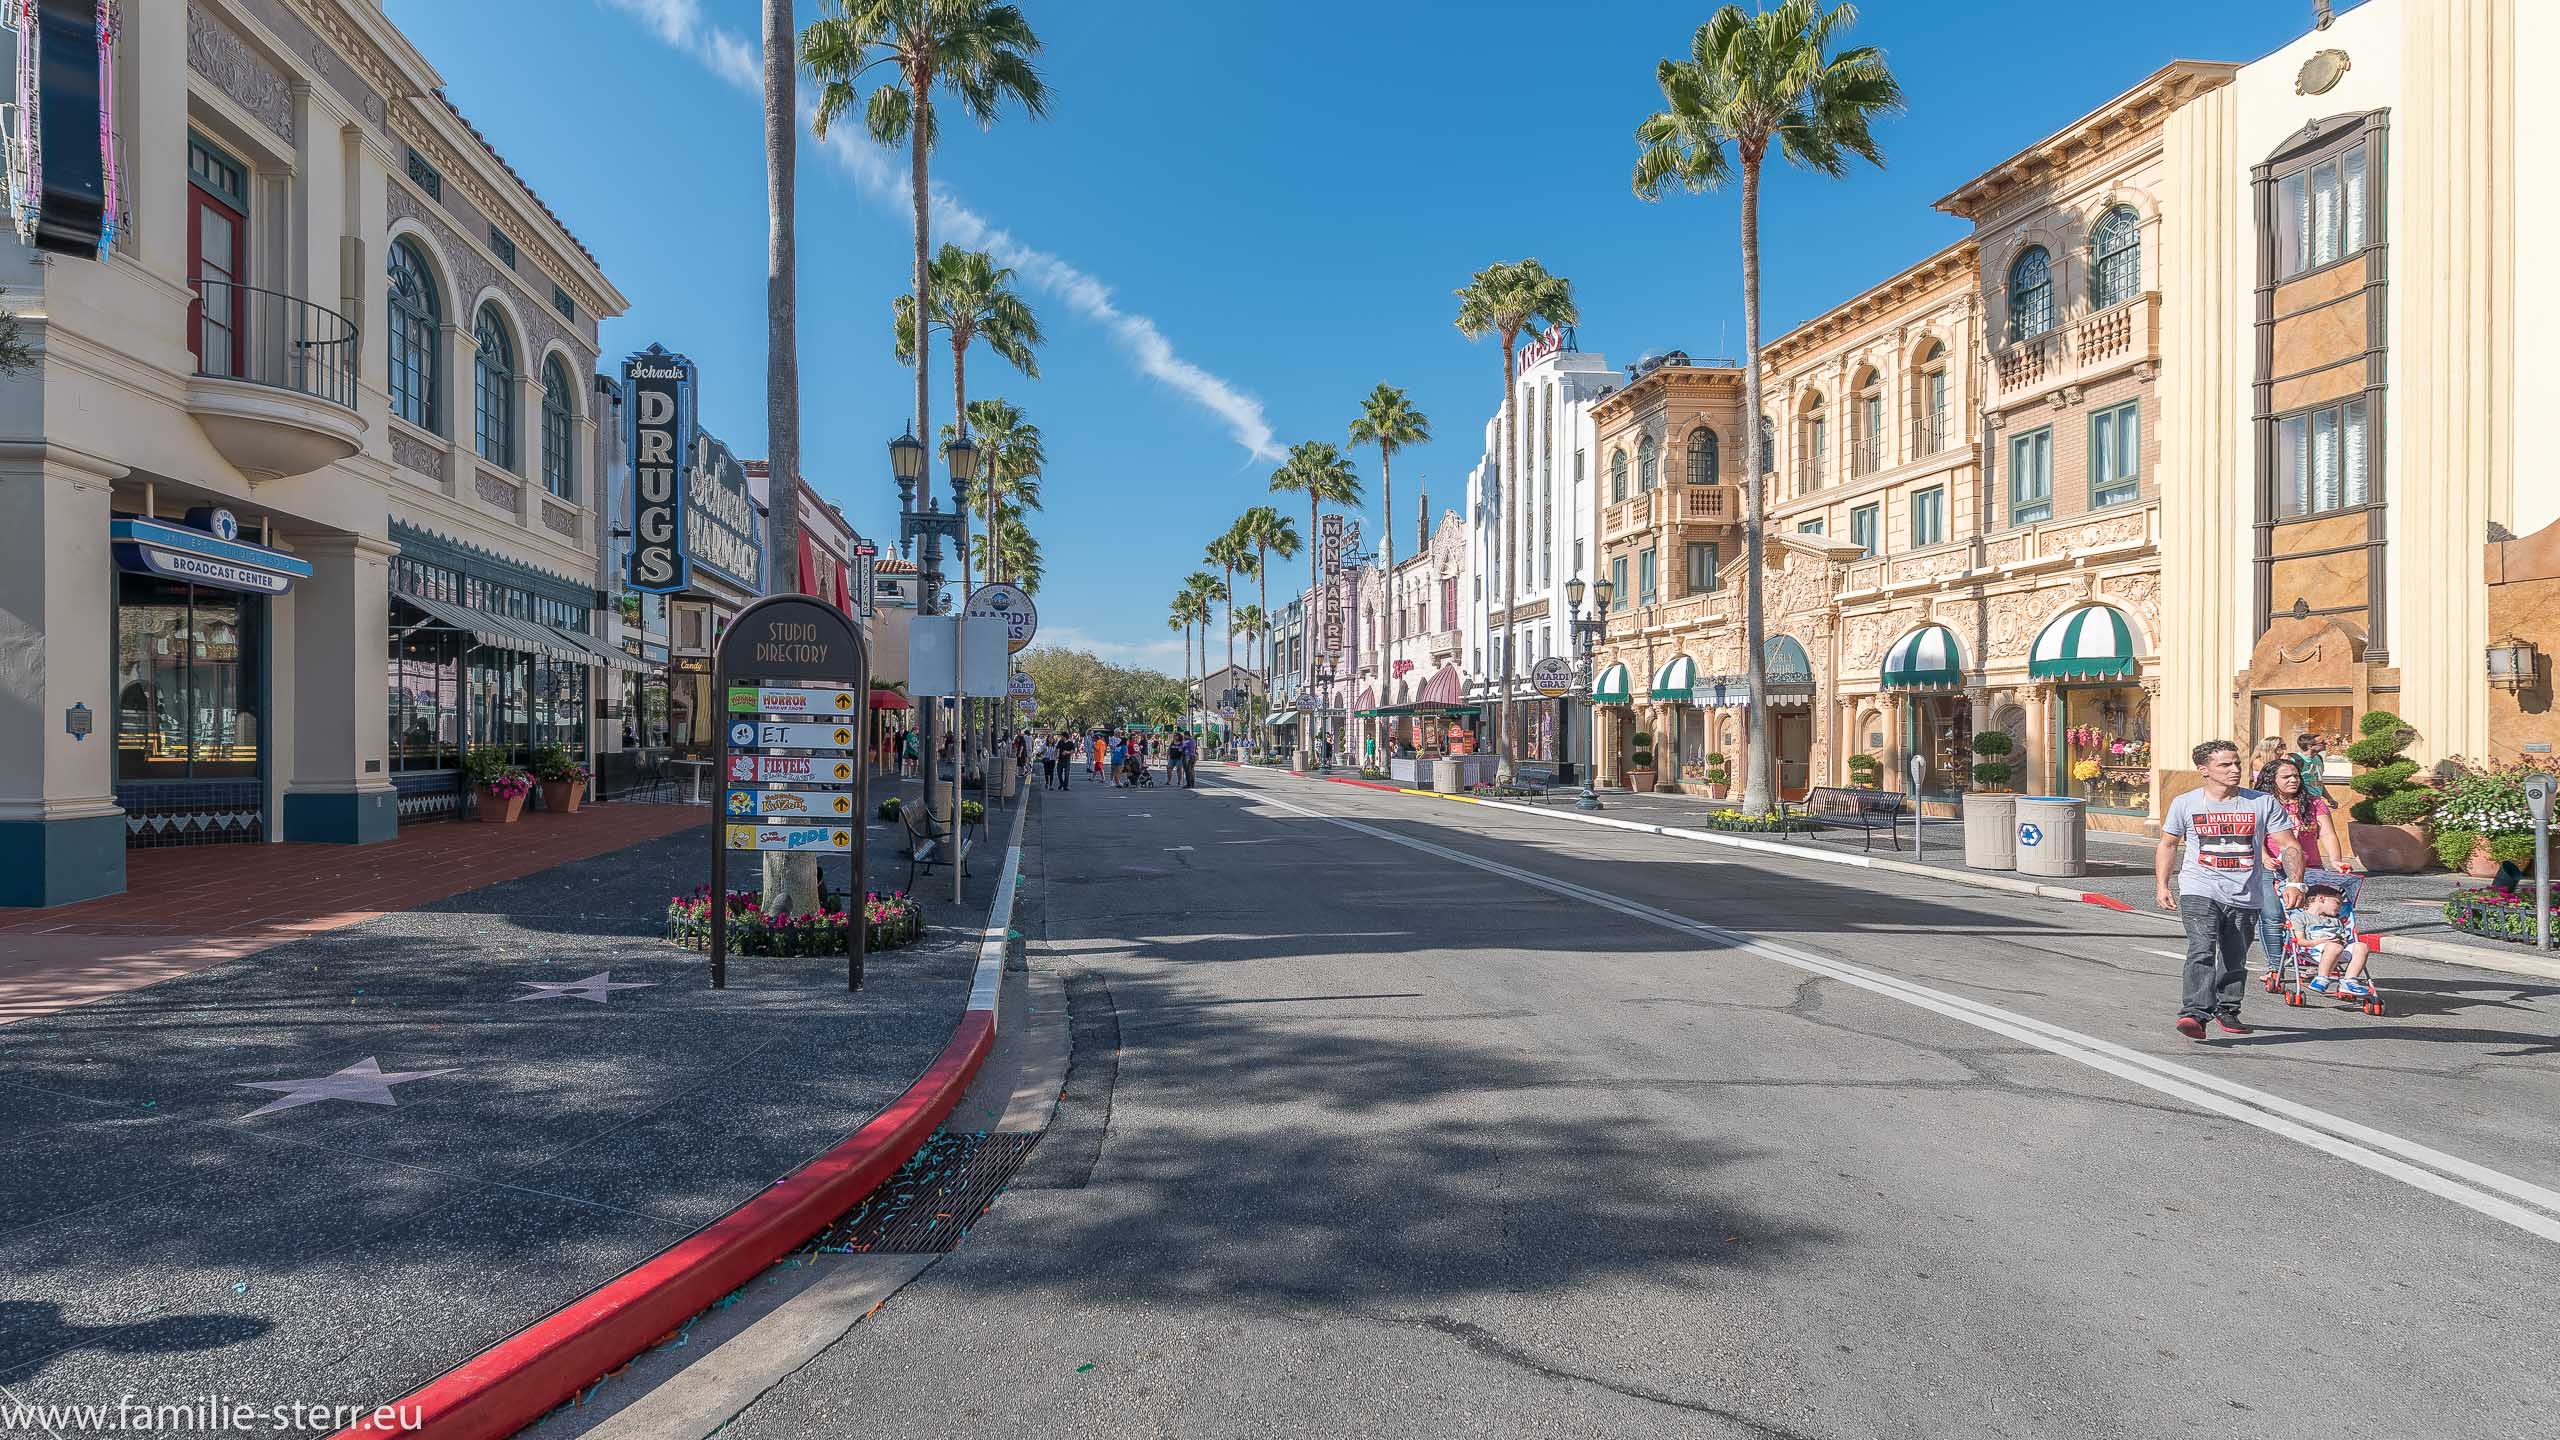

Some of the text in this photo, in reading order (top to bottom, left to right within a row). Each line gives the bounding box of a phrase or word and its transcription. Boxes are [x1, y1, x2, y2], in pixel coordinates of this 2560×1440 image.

[638, 391, 675, 583] DRUGS
[173, 557, 273, 588] BROADCAST CENTER
[1325, 523, 1340, 652] MONTMARTRE
[769, 622, 817, 641] STUDIO
[756, 643, 828, 663] DIRECTORY
[680, 659, 703, 671] Candy
[763, 694, 807, 706] HORROR
[763, 726, 790, 743] E.T.
[764, 758, 810, 774] FIEVEL'S
[2209, 813, 2253, 823] NAUTIQUE
[788, 828, 829, 849] RIDE
[2195, 826, 2218, 834] BOAT
[2217, 859, 2239, 867] SURF
